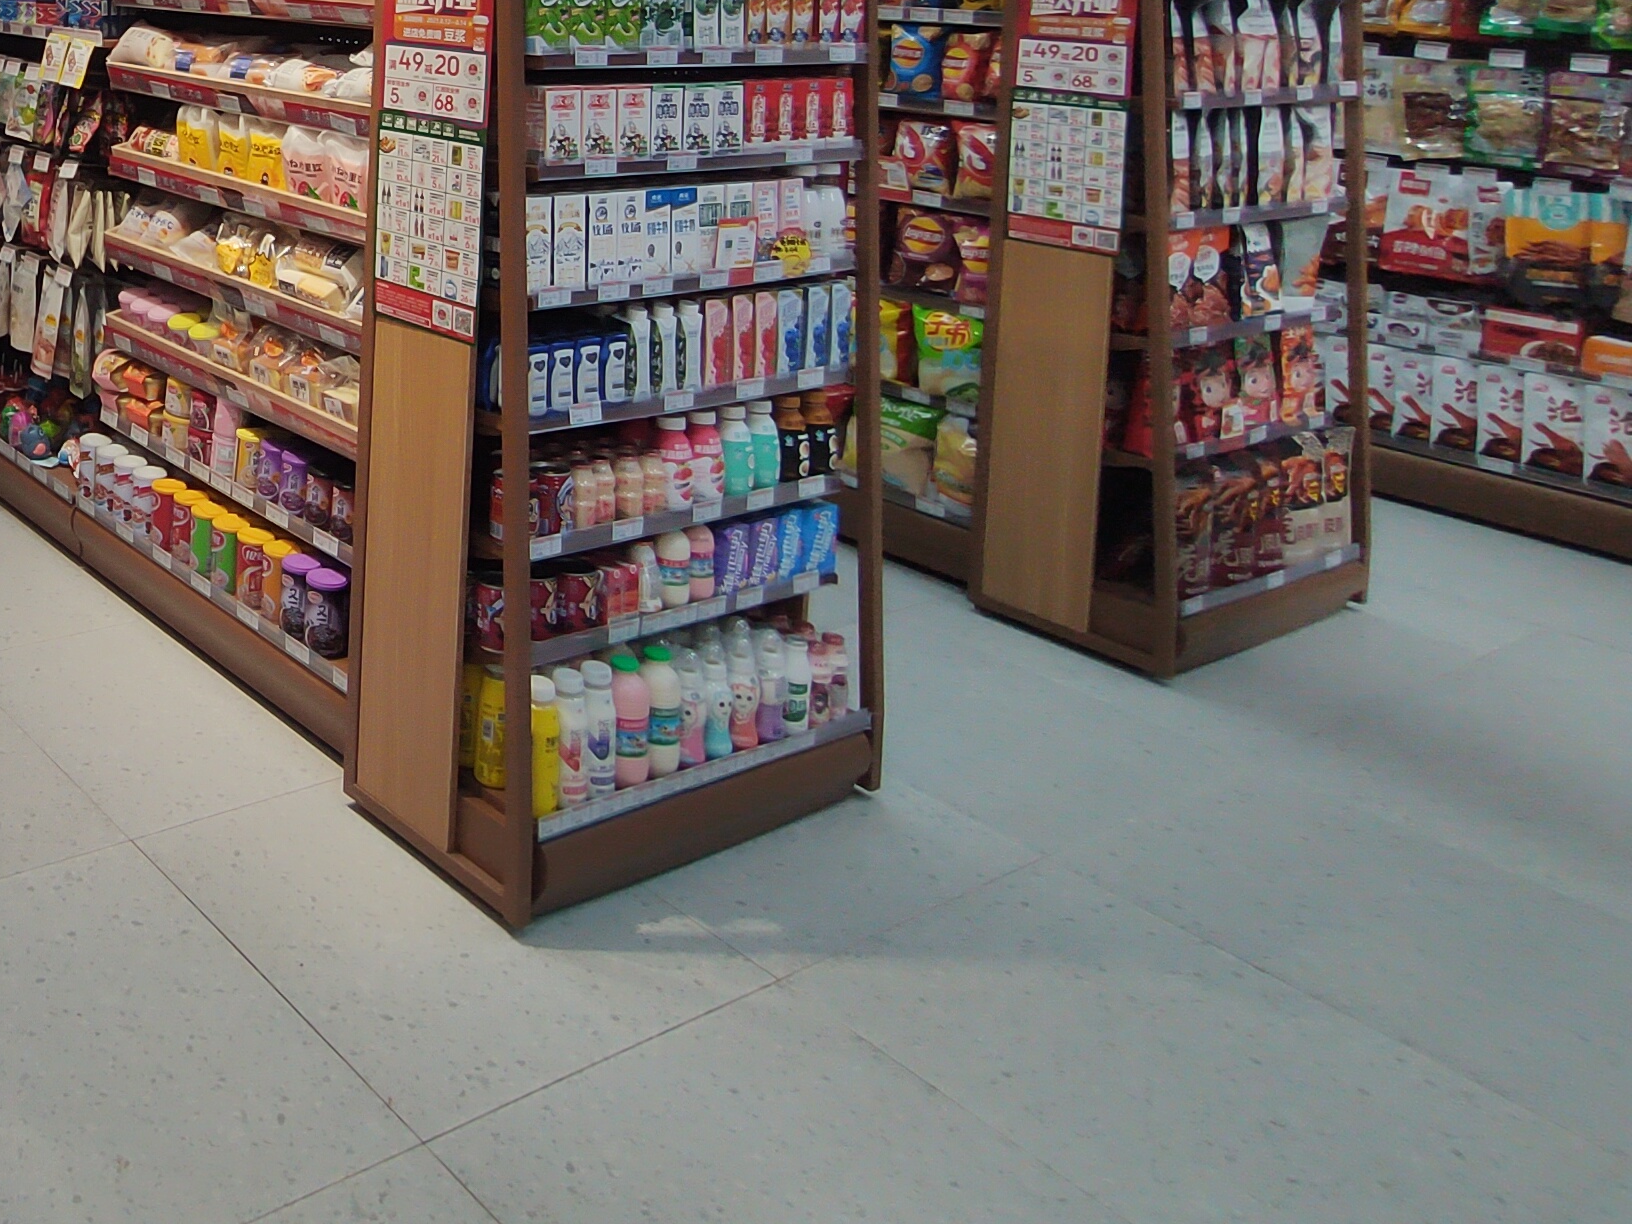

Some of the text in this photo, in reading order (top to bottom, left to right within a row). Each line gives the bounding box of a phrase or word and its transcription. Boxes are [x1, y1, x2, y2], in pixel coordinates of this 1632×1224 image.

[1033, 42, 1099, 62] 49 20
[398, 49, 424, 72] 49
[434, 54, 460, 76] 20
[1023, 70, 1034, 83] 5
[1071, 75, 1093, 88] 68
[390, 87, 400, 104] 5
[434, 93, 454, 112] 68
